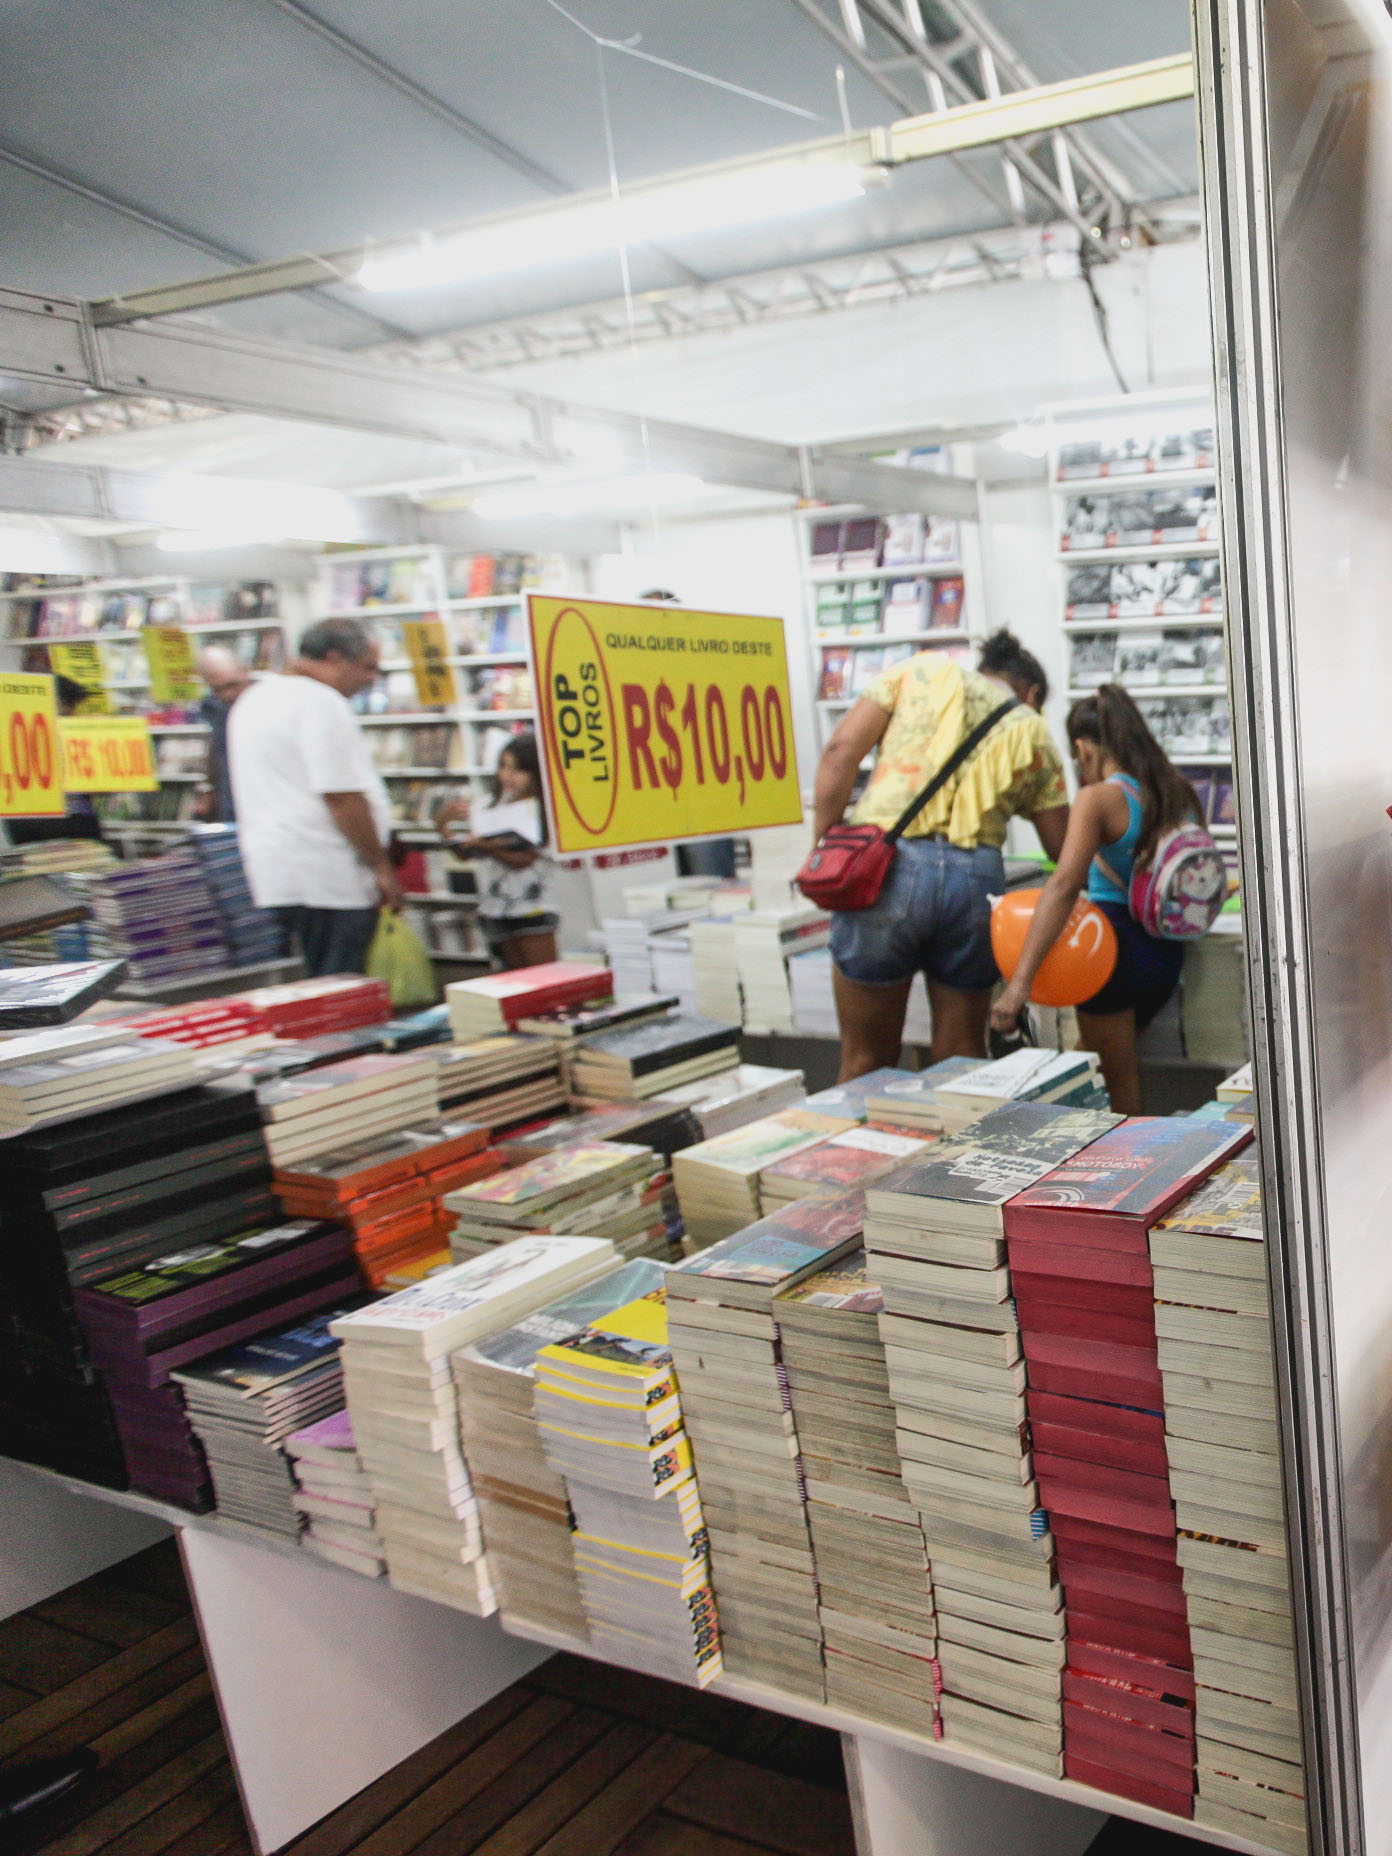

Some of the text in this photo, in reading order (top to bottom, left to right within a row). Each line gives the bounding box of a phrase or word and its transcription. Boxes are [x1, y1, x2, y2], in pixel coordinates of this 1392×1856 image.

[607, 633, 773, 657] QUALQUER LIVRO DESTE
[555, 673, 586, 769] TOP
[580, 662, 609, 781] LIVROS
[621, 677, 787, 807] R$10,00
